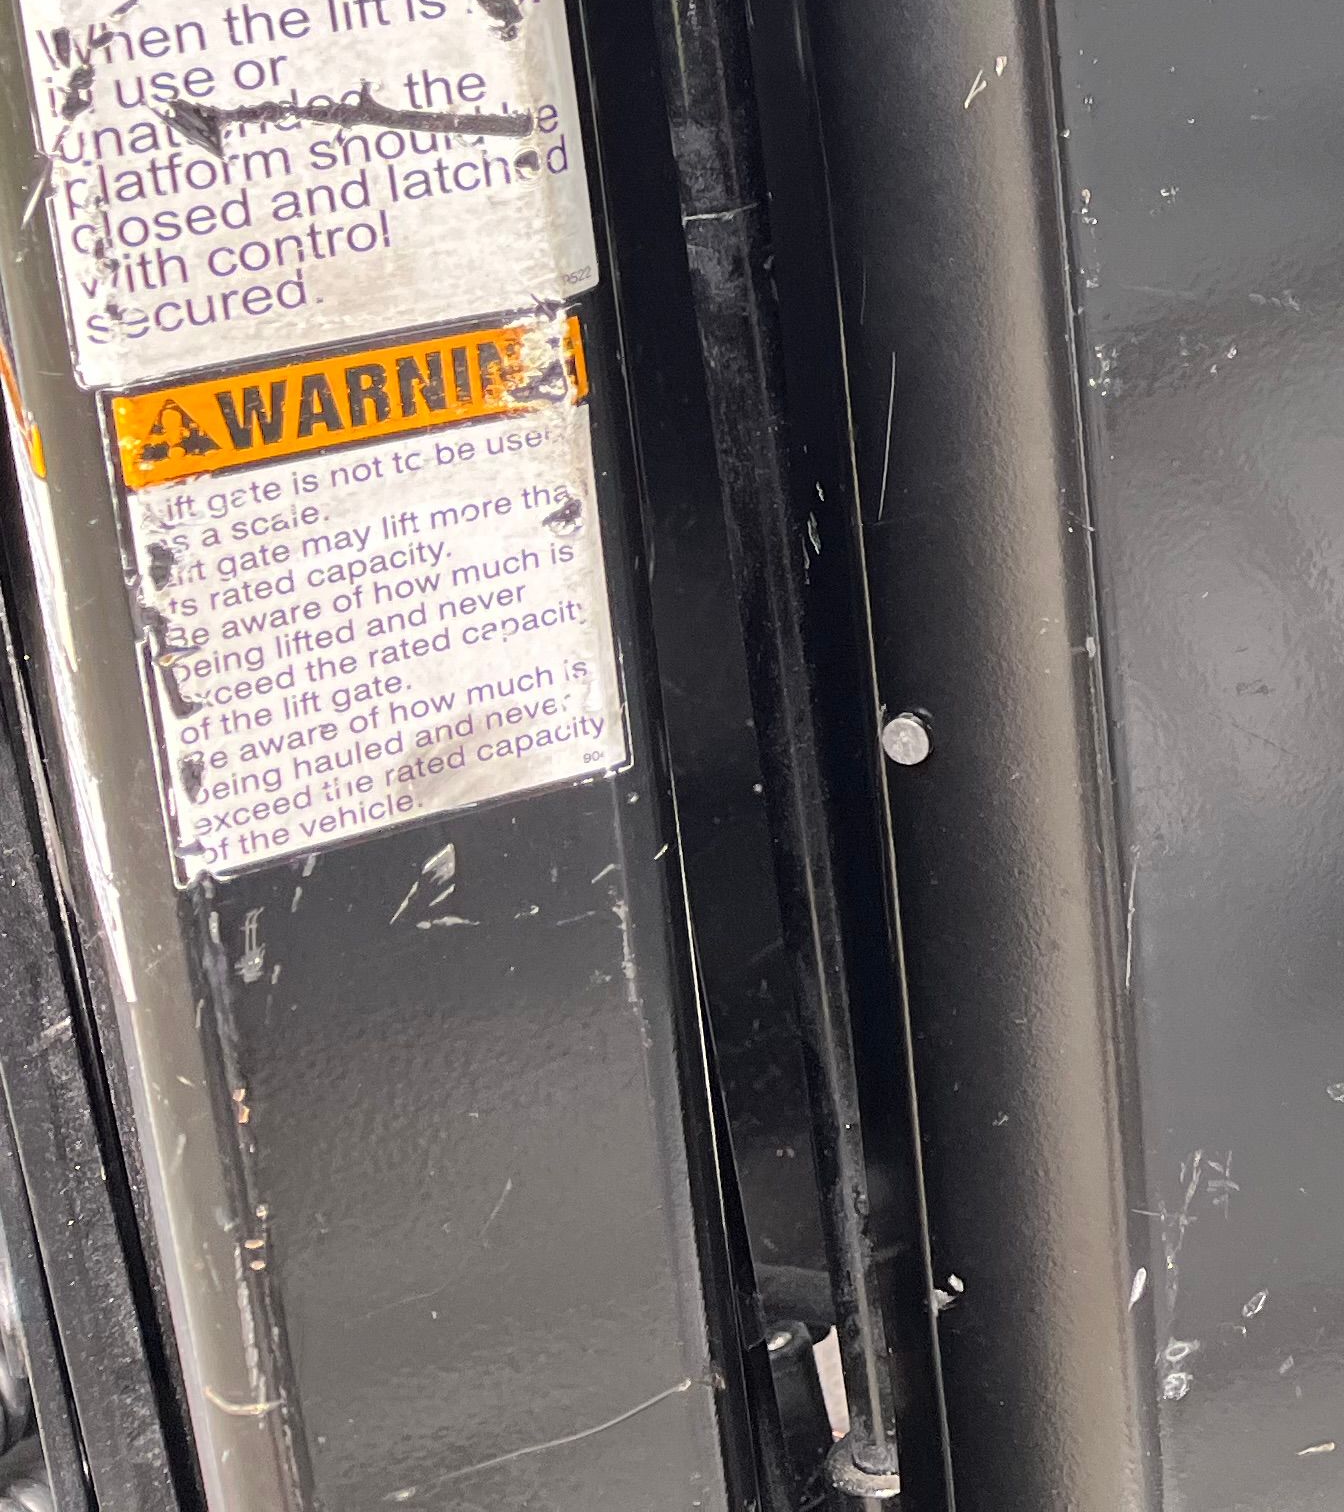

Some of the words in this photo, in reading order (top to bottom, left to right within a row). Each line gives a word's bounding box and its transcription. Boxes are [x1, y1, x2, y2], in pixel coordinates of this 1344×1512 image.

[223, 4, 311, 45] the
[115, 67, 215, 110] use
[234, 55, 287, 90] or
[404, 69, 487, 110] the
[72, 187, 252, 254] closed
[271, 168, 370, 222] and
[208, 209, 391, 276] control
[207, 481, 282, 519] gate
[292, 471, 319, 495] is
[330, 456, 383, 487] not
[435, 441, 476, 465] be
[202, 527, 221, 547] a
[217, 544, 290, 581] gate
[301, 525, 371, 557] may
[383, 512, 420, 539] lift
[430, 496, 512, 529] more
[210, 569, 295, 610] rated
[307, 540, 452, 587] capacity.
[221, 601, 321, 639] aware
[333, 584, 364, 612] of
[374, 573, 440, 604] how
[452, 548, 539, 586] much
[551, 542, 574, 565] is
[275, 619, 355, 659] lifted
[367, 602, 427, 637] and
[439, 584, 526, 620] never
[306, 656, 357, 682] the
[369, 627, 451, 668] rated
[181, 716, 211, 745] of
[220, 707, 272, 735] the
[283, 691, 321, 720] lift
[332, 675, 411, 713] gate.
[239, 722, 338, 762] aware
[350, 705, 380, 733] of
[390, 692, 456, 724] how
[467, 666, 553, 705] much
[564, 659, 588, 682] is
[194, 784, 312, 835] exceed
[386, 745, 465, 786] rated
[477, 715, 605, 762] capacity
[293, 731, 404, 779] hauled
[415, 714, 474, 748] and
[238, 827, 290, 855] the
[300, 794, 423, 838] vehicle.
